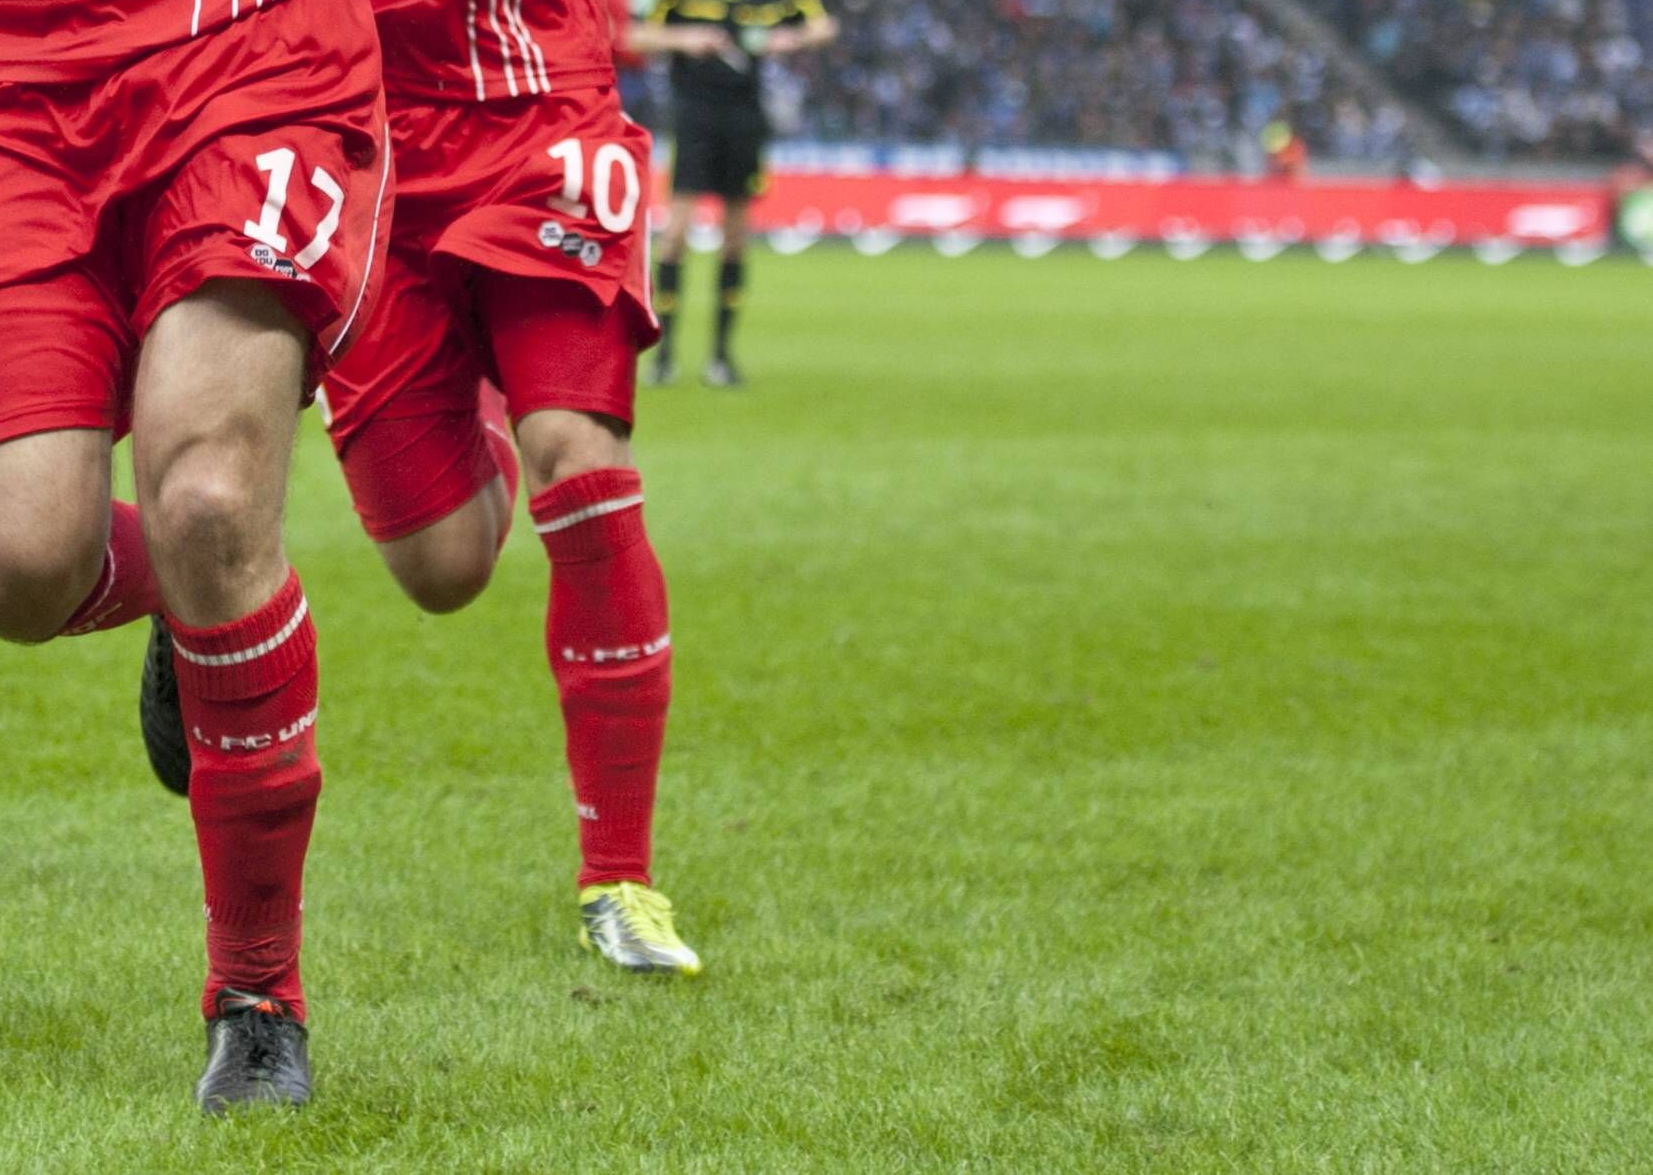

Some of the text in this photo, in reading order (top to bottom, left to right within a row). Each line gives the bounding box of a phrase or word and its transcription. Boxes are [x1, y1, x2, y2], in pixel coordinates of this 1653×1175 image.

[243, 147, 345, 271] 17
[547, 137, 640, 233] 10
[221, 733, 272, 751] FC
